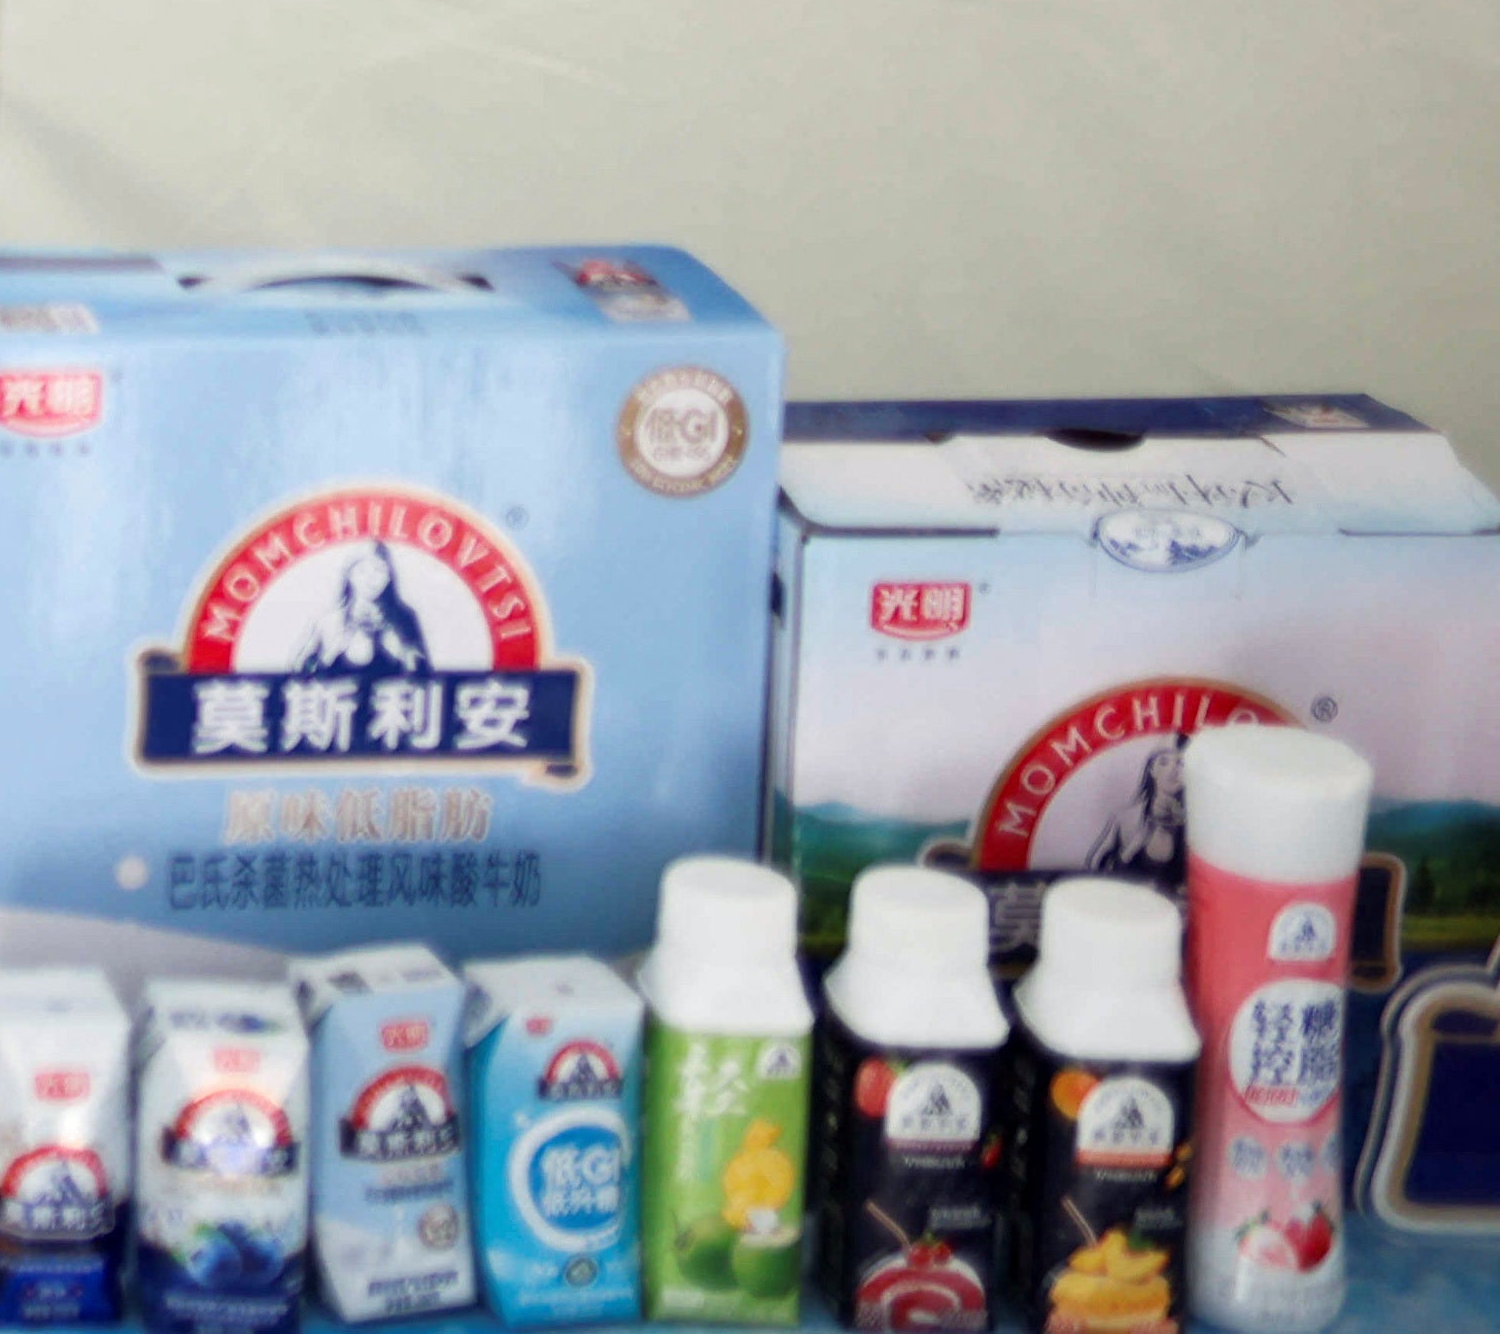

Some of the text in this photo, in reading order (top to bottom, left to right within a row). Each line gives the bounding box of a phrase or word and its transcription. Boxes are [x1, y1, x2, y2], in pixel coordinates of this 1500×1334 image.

[203, 504, 534, 645] MOMCHILOVTSI
[879, 586, 966, 624] 光明
[194, 680, 530, 753] 莫斯利安
[999, 695, 1259, 838] MOMCHILO
